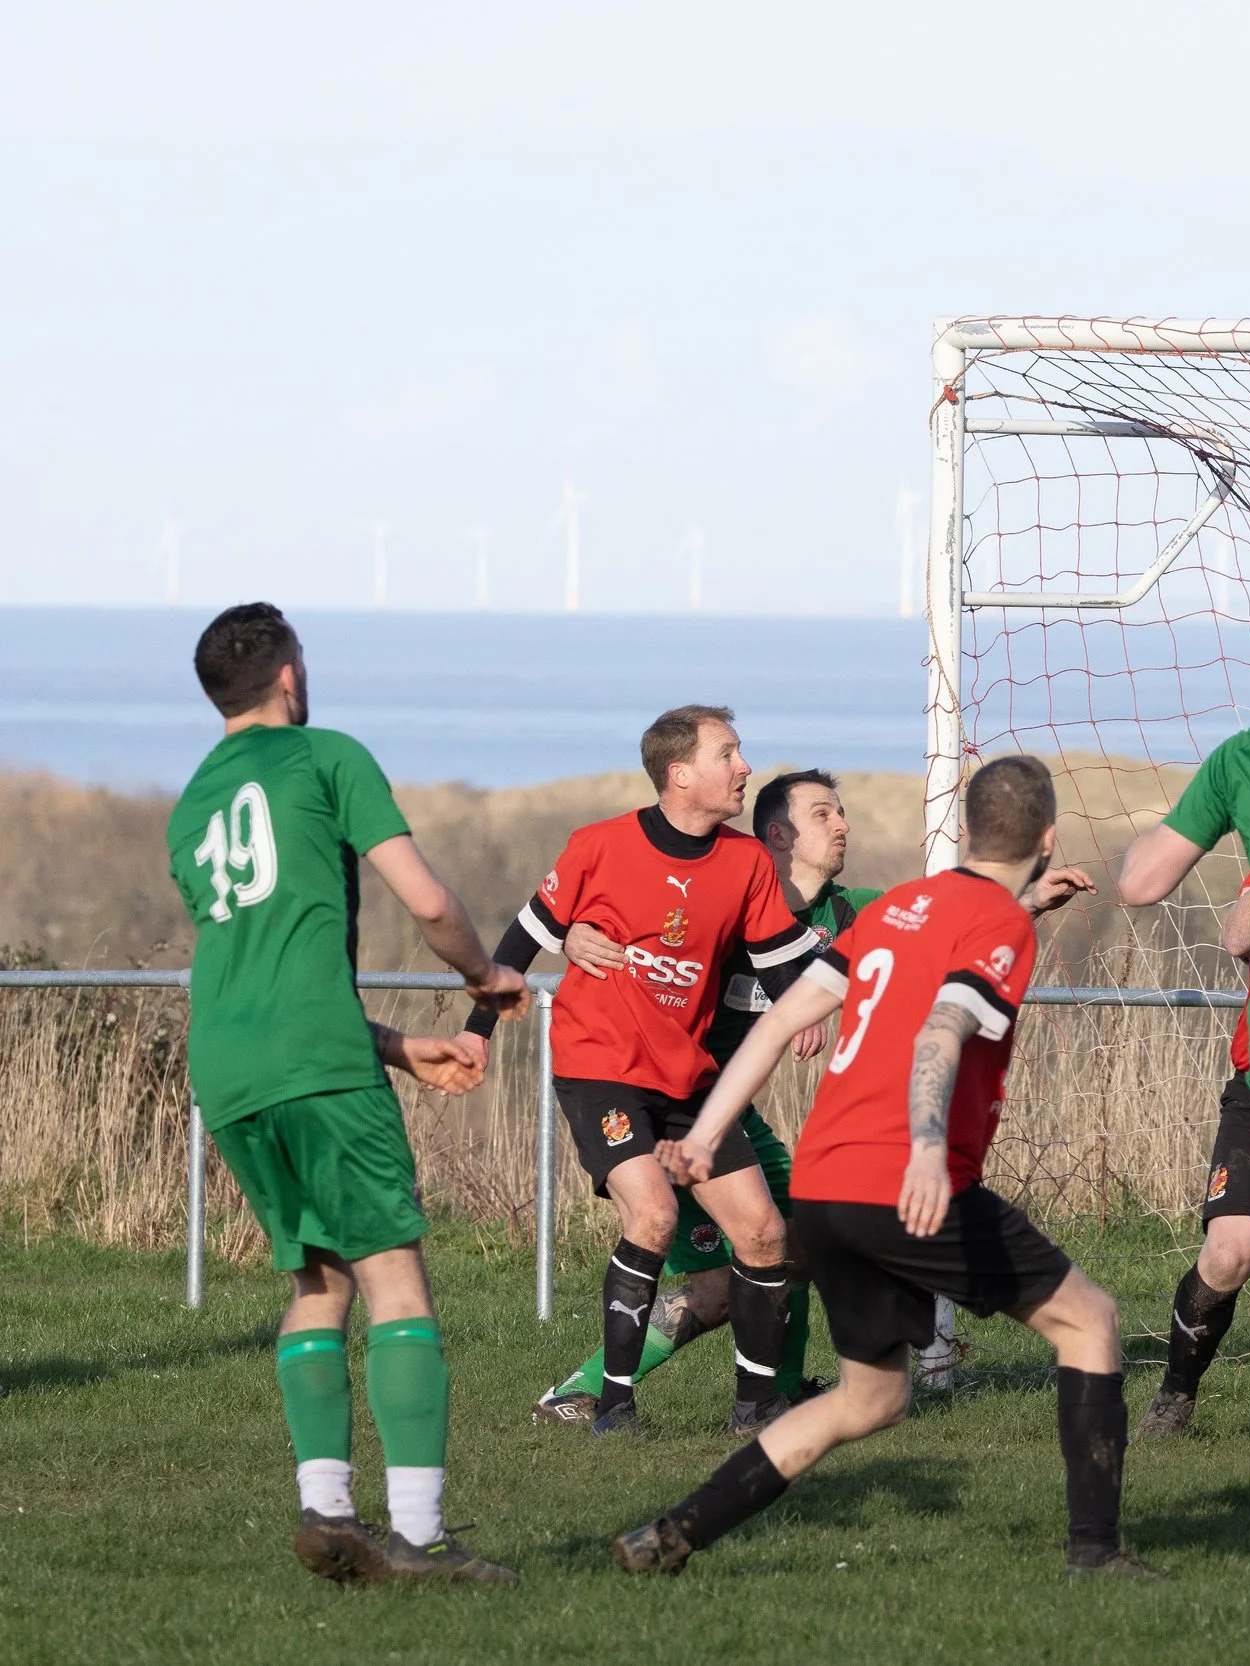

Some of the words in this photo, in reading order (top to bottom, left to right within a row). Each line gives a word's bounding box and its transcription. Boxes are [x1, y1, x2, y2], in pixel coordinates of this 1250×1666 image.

[194, 781, 278, 923] 19
[625, 944, 704, 988] PSS
[655, 993, 689, 1009] ENTRE
[828, 947, 895, 1075] 3
